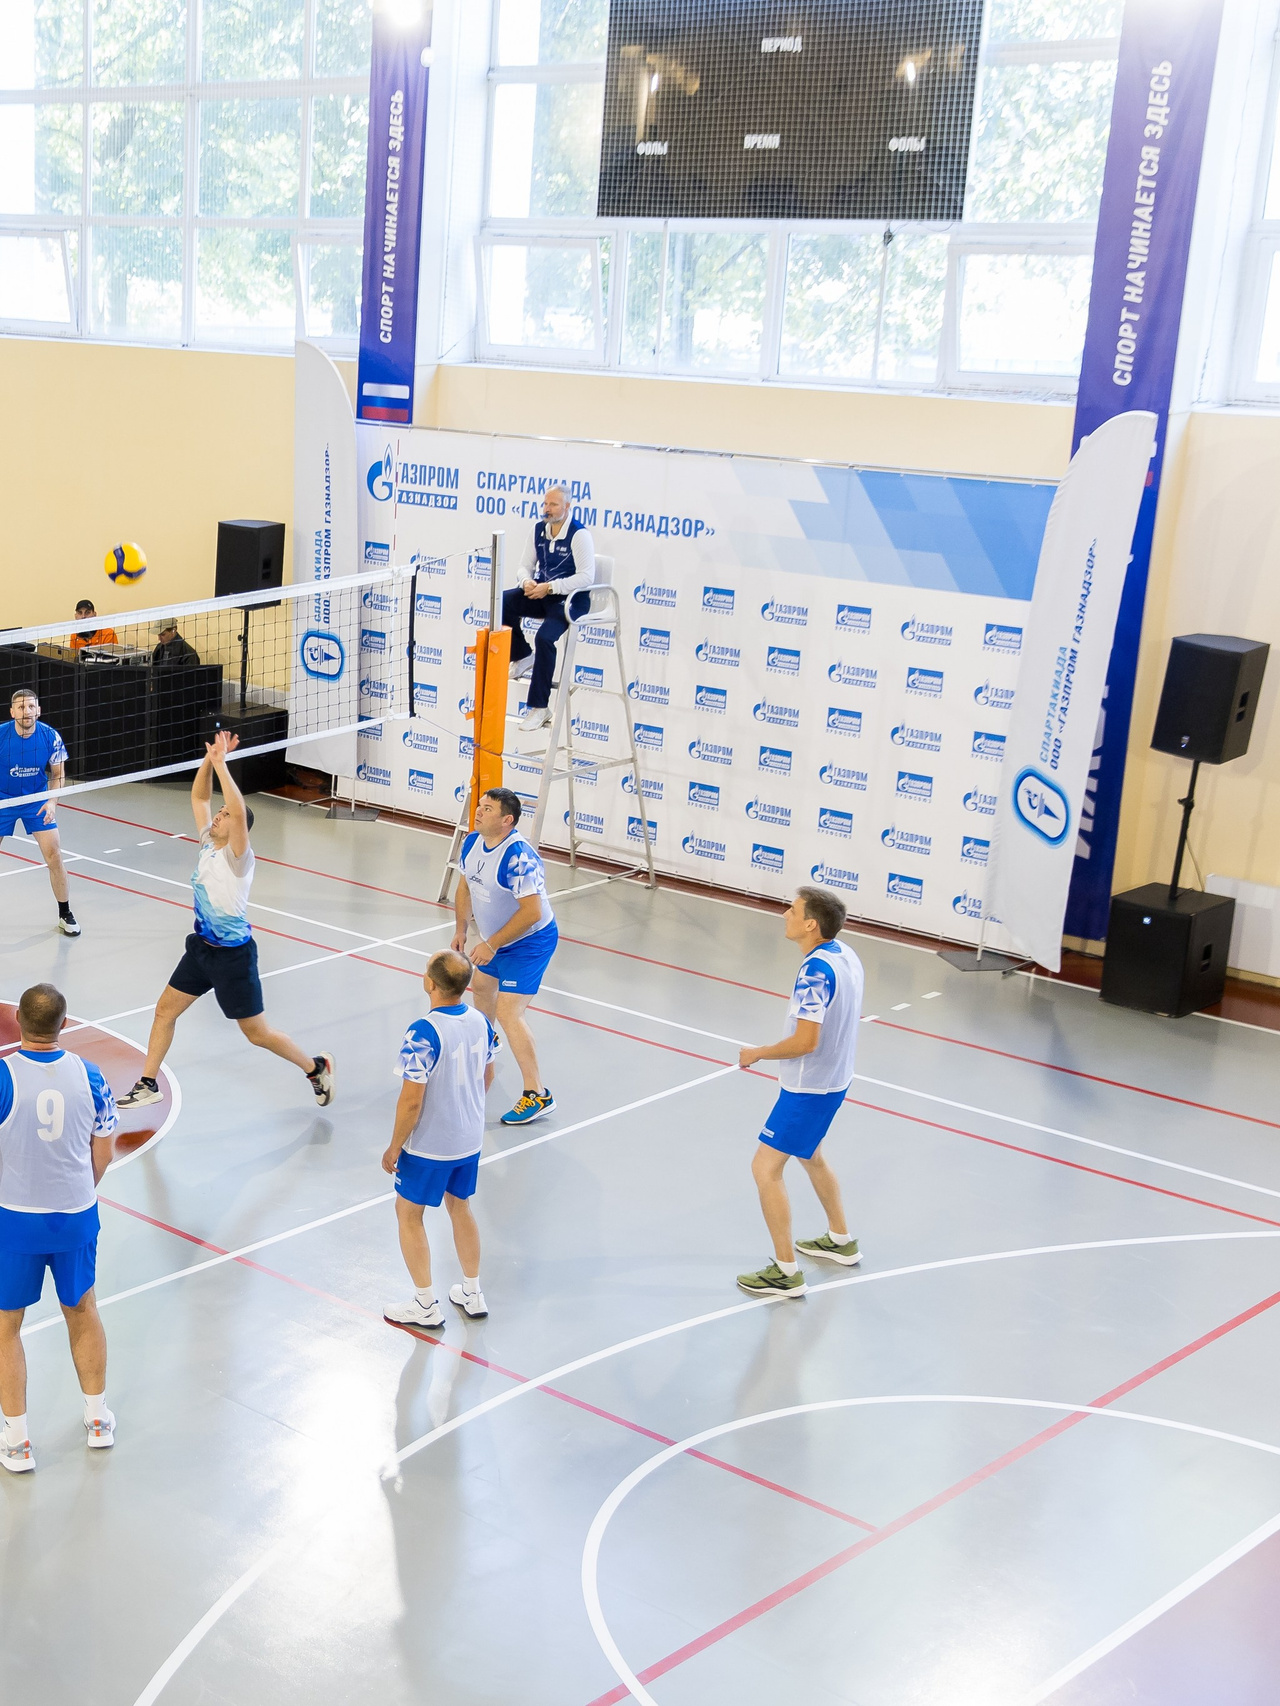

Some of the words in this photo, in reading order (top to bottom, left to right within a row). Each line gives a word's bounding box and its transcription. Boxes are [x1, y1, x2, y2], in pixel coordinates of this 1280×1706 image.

[1144, 59, 1173, 140] ЗДЕСЬ
[388, 89, 405, 153] ЗДЕСЬ
[382, 155, 402, 281] НАЧИНАЕТСЯ
[1122, 145, 1161, 303] НАЧИНАЕТСЯ
[379, 283, 395, 345] СПОРТ
[1112, 307, 1140, 387] СПОРТ
[398, 462, 459, 490] АЗПРОМ
[476, 495, 506, 516] ООО
[512, 500, 597, 527] «ГАОМ
[603, 510, 715, 539] ГАЗНАДЗОР»
[314, 530, 322, 623] СПААКИАДА
[775, 603, 808, 617] ГАЗПРОМ
[709, 645, 741, 658] ГАЗПРОМ
[842, 665, 877, 680] ГАЗПРОМ
[640, 684, 670, 696] ГАЗПРОМ
[990, 687, 1015, 700] ГАЗПР
[767, 705, 800, 719] ГАЗПРОМ
[1040, 646, 1068, 764] СПАРТАКИАДА
[1050, 742, 1062, 771] ООО
[1058, 649, 1079, 733] «ГАЗПРОМ
[580, 720, 609, 734] ГАЗПРОМ
[906, 728, 942, 743] ГАЗПРОМ
[701, 742, 733, 757] ГАЗПРОМ
[834, 767, 868, 783] ГАЗПРОМ
[760, 802, 792, 818] ГАЗПРОМ
[575, 812, 604, 826] ГАЗПРОМ
[695, 837, 726, 853] ГАЗПРОМ
[896, 830, 932, 846] ГАЗПРОМ
[825, 866, 859, 883] ГАЗПРОМ
[451, 1036, 485, 1086] 11
[36, 1089, 65, 1142] 9
